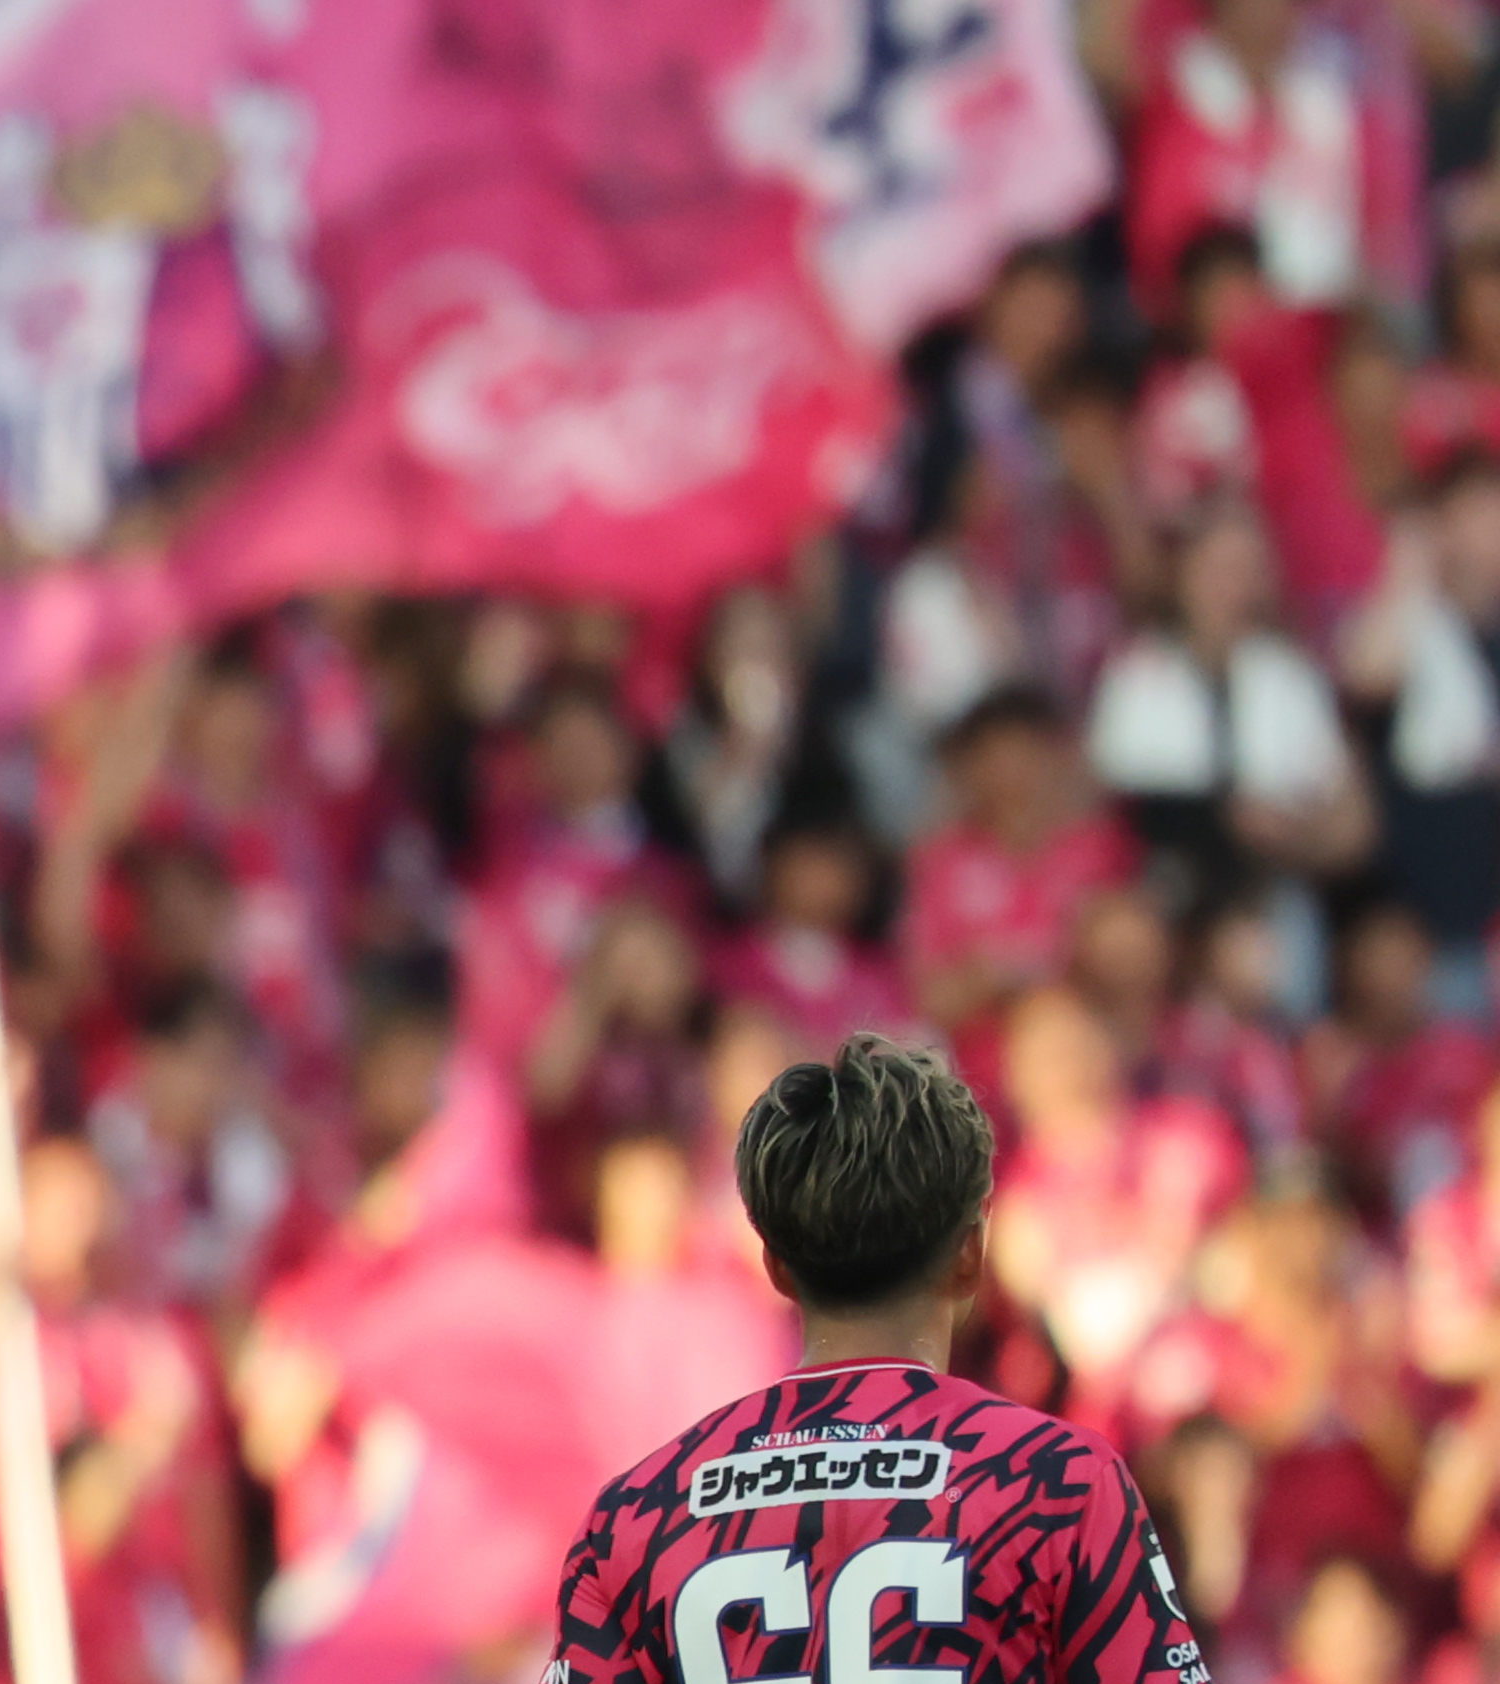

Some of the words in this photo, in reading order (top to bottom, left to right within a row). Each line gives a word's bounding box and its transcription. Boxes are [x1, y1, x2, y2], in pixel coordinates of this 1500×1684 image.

[751, 1428, 816, 1450] SCHAU
[820, 1423, 890, 1441] ESSEN
[699, 1448, 940, 1508] シャウエッセン
